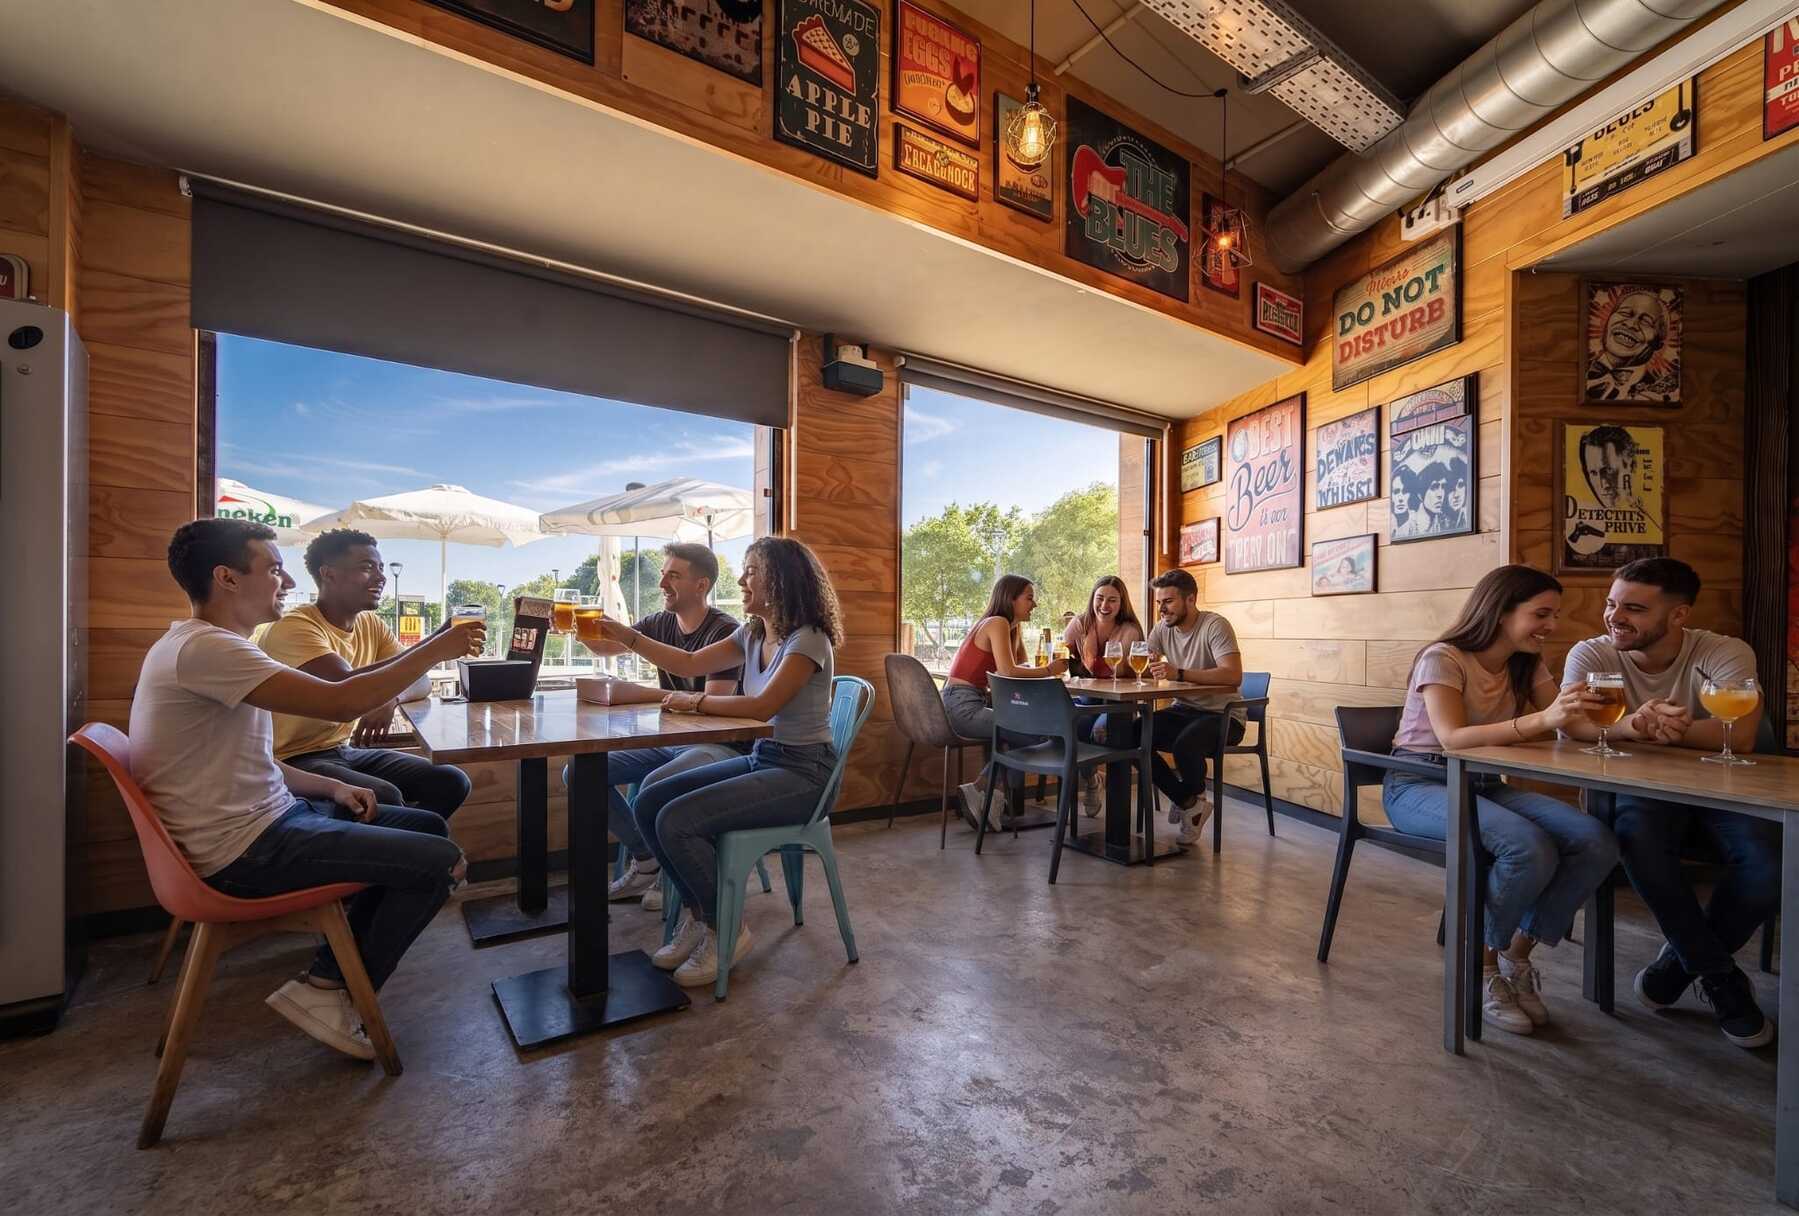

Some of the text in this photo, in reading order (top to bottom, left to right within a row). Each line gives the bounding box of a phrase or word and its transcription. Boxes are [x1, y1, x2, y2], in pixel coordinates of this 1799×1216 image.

[786, 74, 871, 128] APPLE
[804, 107, 853, 147] PIE
[1120, 149, 1176, 214] THE
[1085, 194, 1179, 272] BLUES
[1339, 301, 1375, 336] DO
[1382, 264, 1444, 316] NOT
[1339, 297, 1445, 364] DISTURB
[1249, 405, 1294, 461] BEST
[217, 508, 292, 528] neken
[1228, 450, 1295, 532] Beer
